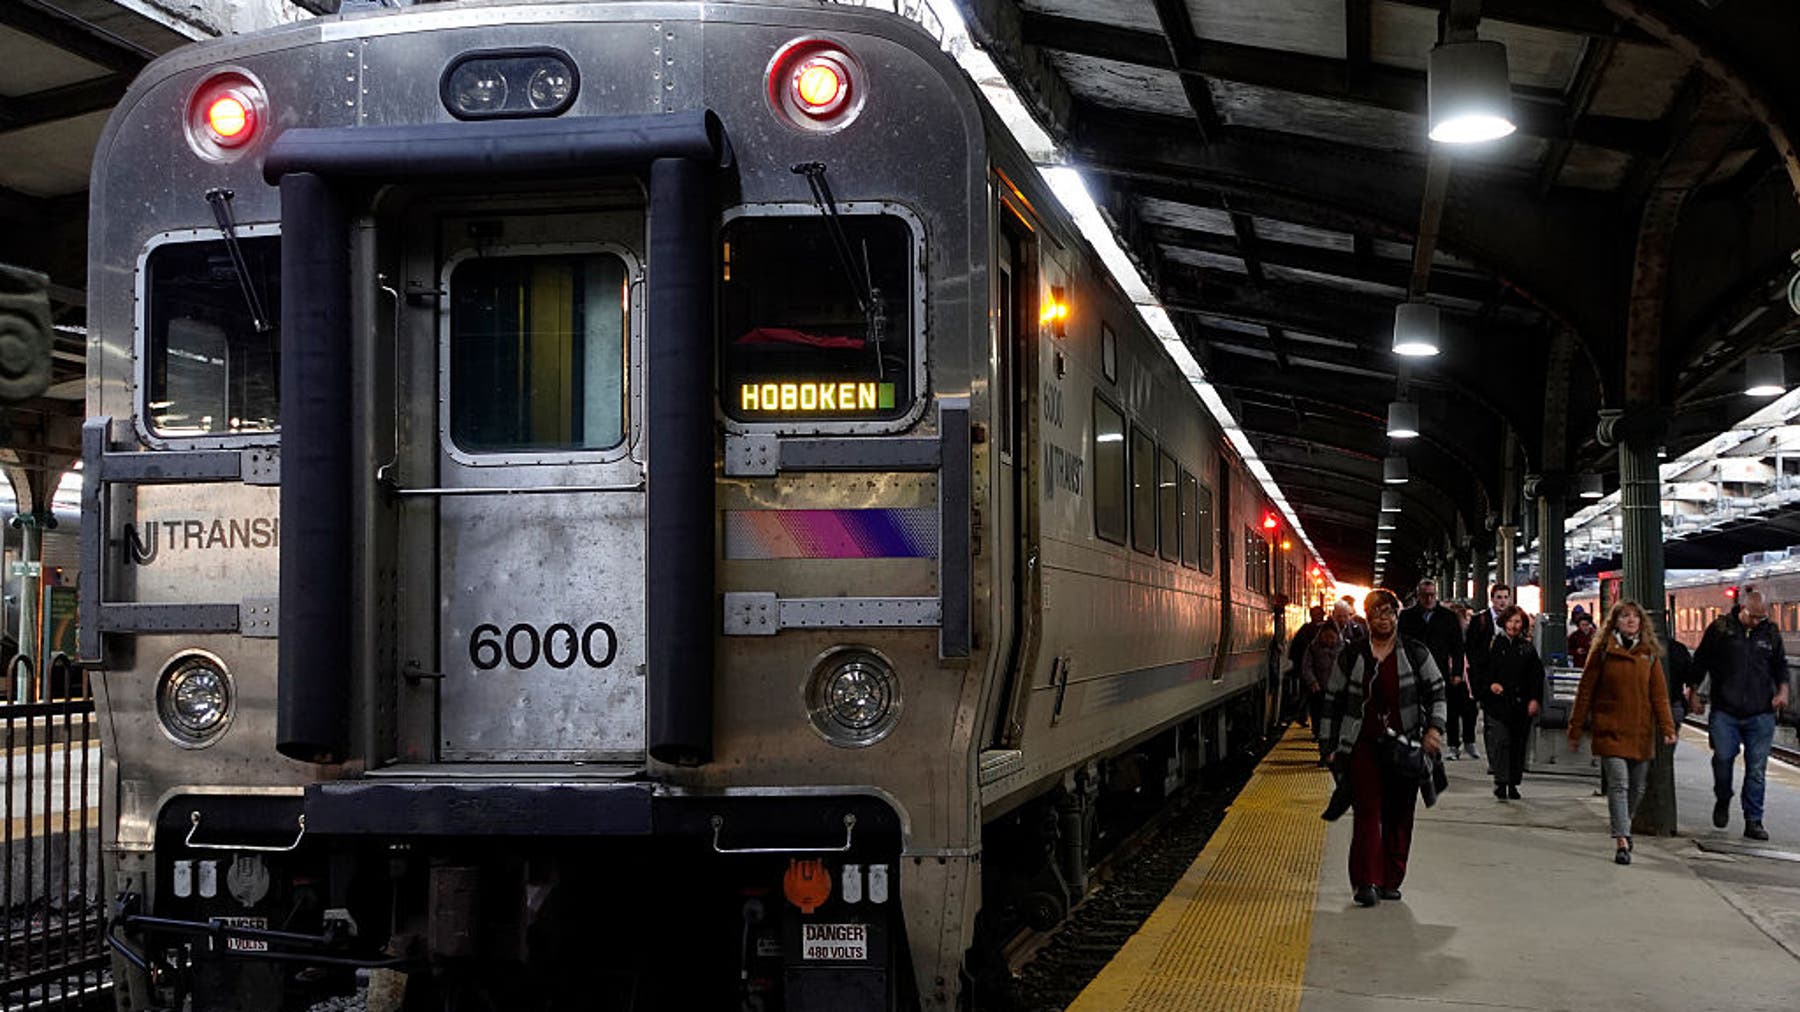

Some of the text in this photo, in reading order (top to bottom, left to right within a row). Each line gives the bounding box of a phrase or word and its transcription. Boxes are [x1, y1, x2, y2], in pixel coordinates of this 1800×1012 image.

[741, 382, 877, 410] HOBOKEN
[163, 518, 279, 549] TRANSI
[469, 622, 618, 670] 6000
[806, 925, 864, 941] DANGER
[808, 946, 864, 958] 480 VOLTS
